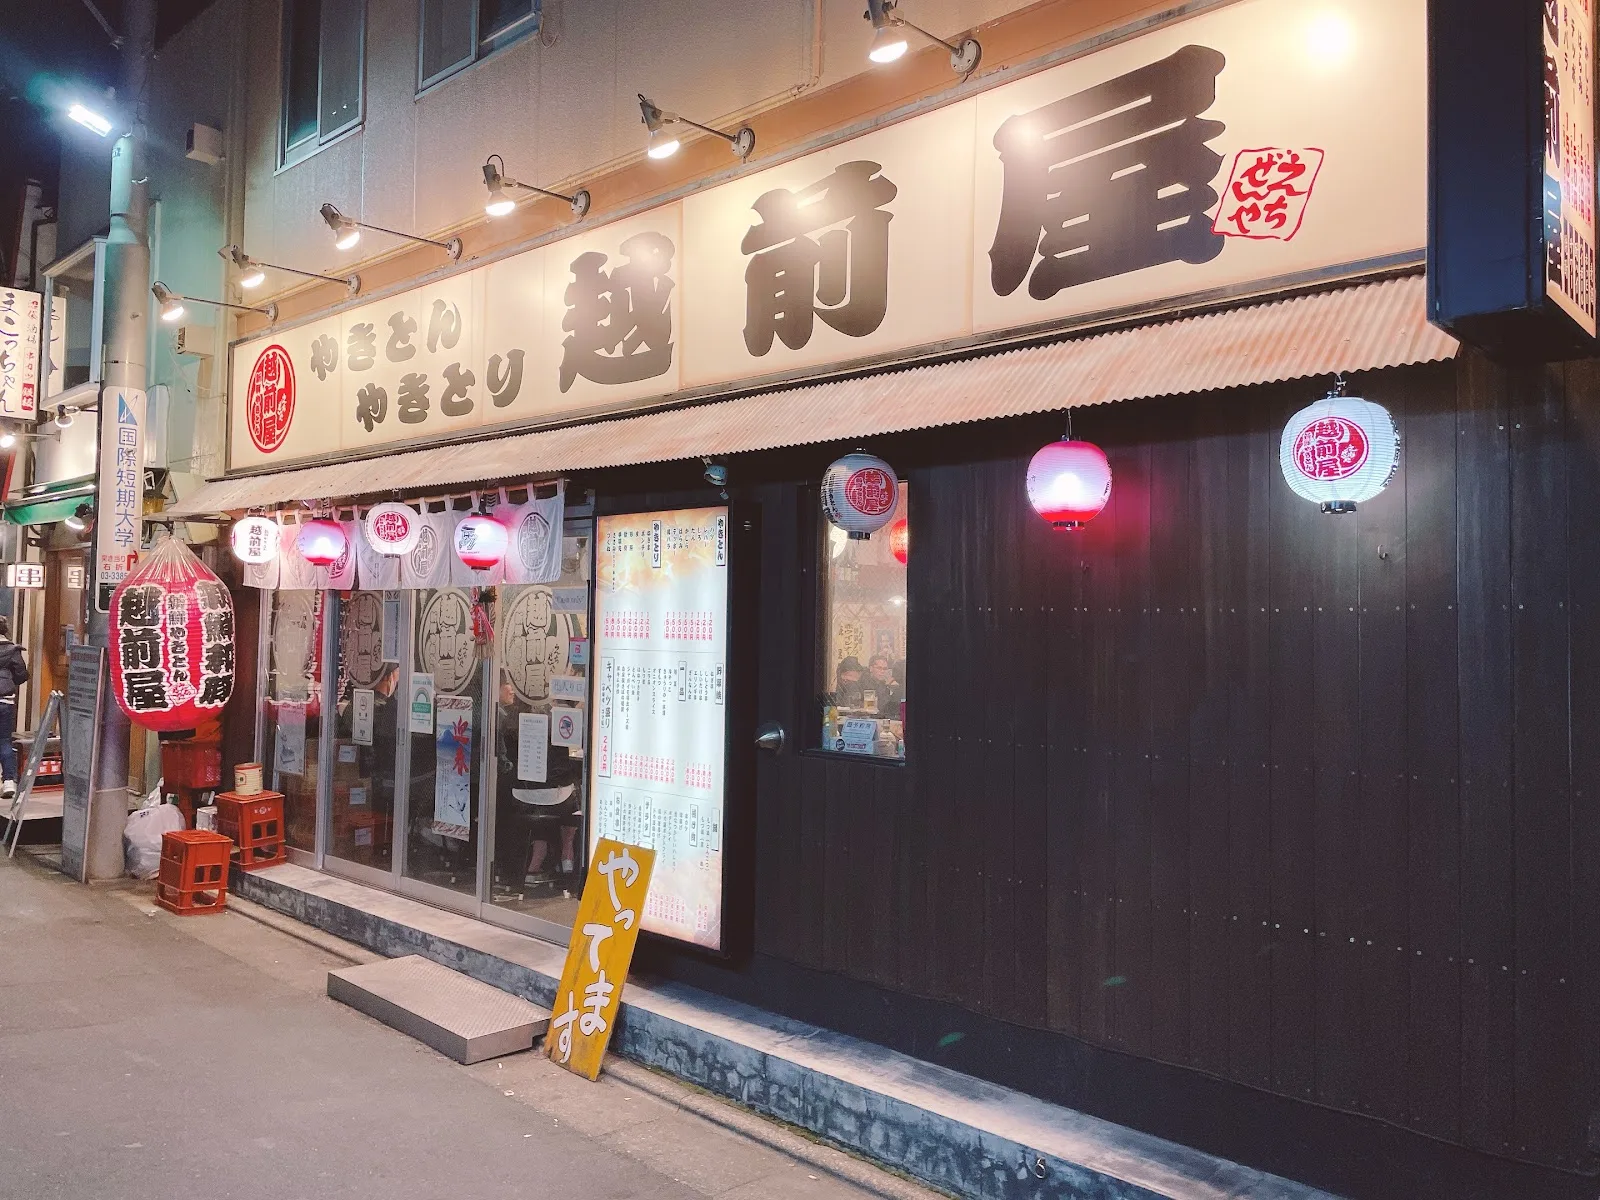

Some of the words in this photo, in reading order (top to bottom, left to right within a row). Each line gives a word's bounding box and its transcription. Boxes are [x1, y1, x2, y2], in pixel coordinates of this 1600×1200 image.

[555, 45, 1227, 393] 越前屋
[311, 299, 462, 382] やきとん
[264, 352, 277, 446] 越前屋
[356, 349, 525, 433] やきとり
[115, 427, 137, 548] 国際短期大学
[1315, 420, 1341, 478] 越前屋
[18, 568, 41, 584] 串
[248, 524, 263, 557] 越前屋
[120, 586, 171, 710] 越前屋
[553, 848, 640, 1063] やってます
